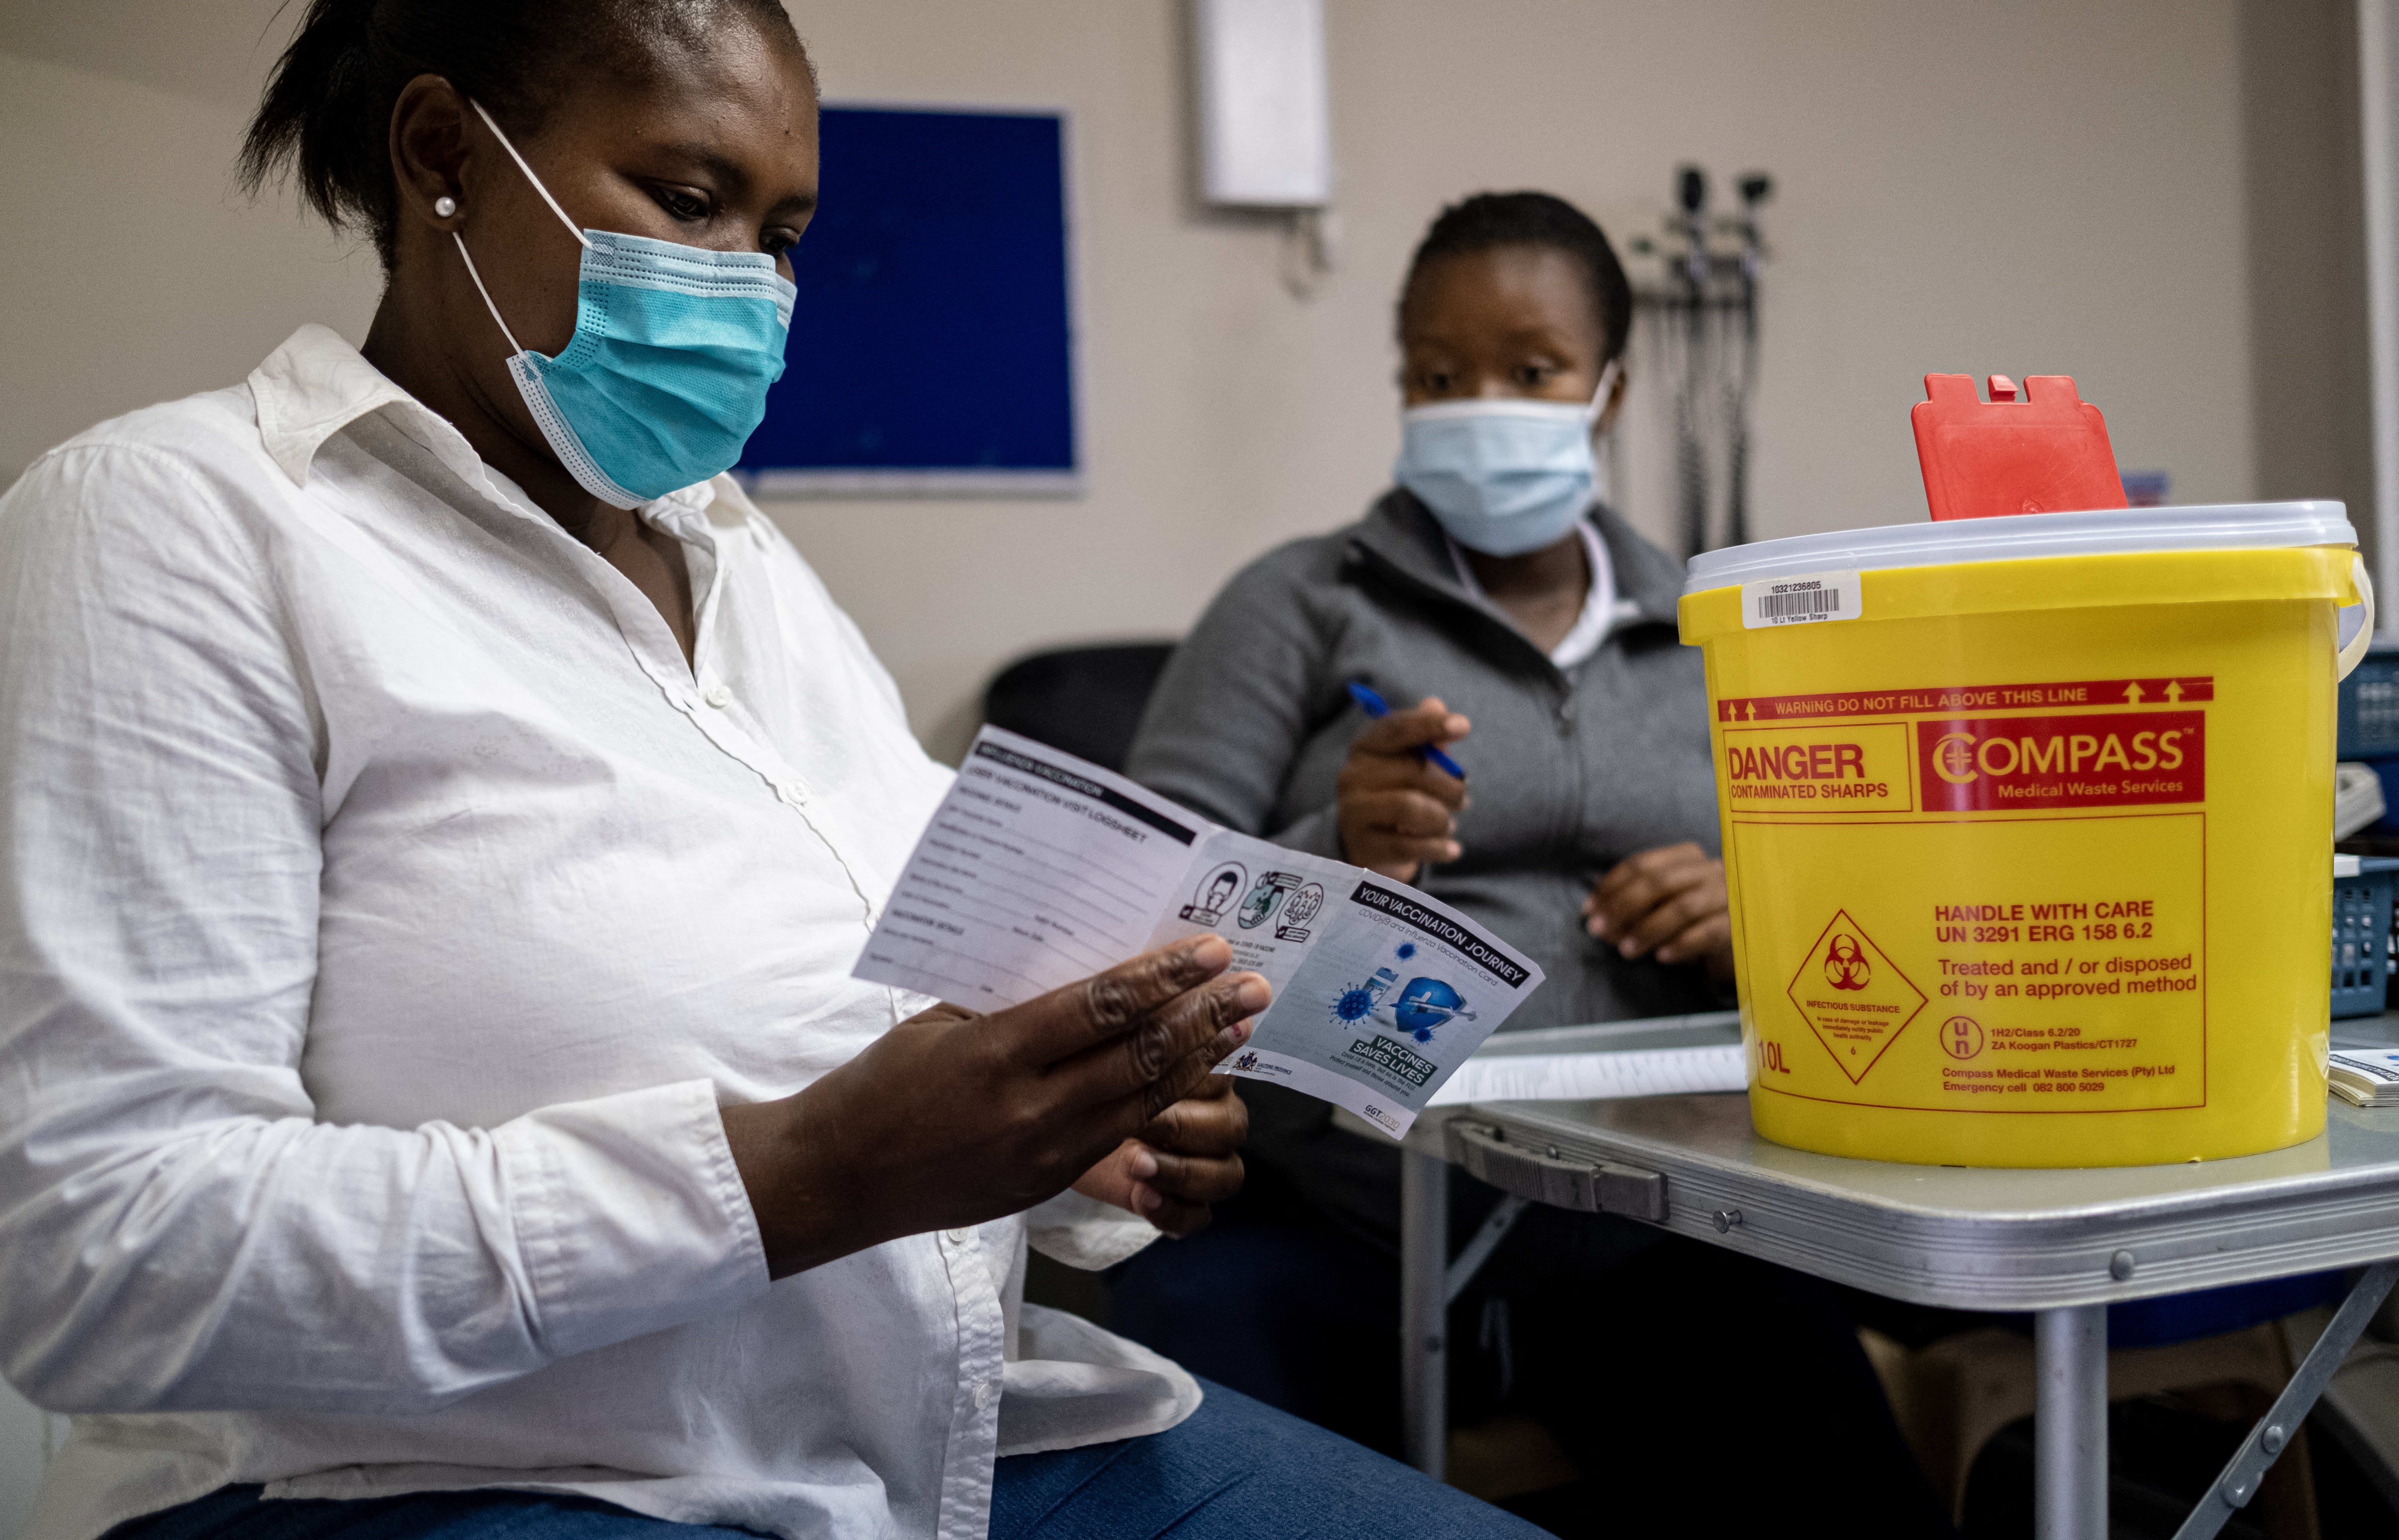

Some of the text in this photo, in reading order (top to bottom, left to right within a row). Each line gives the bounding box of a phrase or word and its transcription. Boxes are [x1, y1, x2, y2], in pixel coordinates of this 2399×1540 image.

[1771, 581, 1821, 594] 10321236805
[1775, 688, 2088, 714] WARNING DO NOT FILL ABOVE THIS LINE
[1729, 744, 1865, 780] DANGER
[1731, 783, 1888, 799] CONTAMINATED SHARPS
[1998, 780, 2183, 798] Medical Waste Services
[1935, 900, 2154, 921] HANDLE WITH CARE
[1360, 887, 1523, 982] YOUR VACCINATION JOURNEY
[1937, 922, 2153, 943] UN 3291 ERG 158 6.2
[1359, 908, 1499, 986] COVID-19 and Influenza Vaccination Card
[1938, 953, 2192, 976] Treated and / or disposed
[1940, 975, 2197, 1000] of by an approved method
[1806, 1000, 1900, 1013] INFECTIOUS SUBSTANCE
[1991, 1028, 2081, 1037] 1H2/Class 6.2/20
[1376, 1037, 1433, 1074] VACCINES
[1850, 1046, 1856, 1055] 6
[1991, 1039, 2138, 1052] ZA Koogan Plastics/CT1727
[1341, 1051, 1361, 1063] Covid-19
[1353, 1043, 1424, 1083] SAVES LIVES
[1758, 1039, 1790, 1074] 10L
[1942, 1065, 2175, 1079] Compass Medical Waste Services (Pty) Ltd
[1943, 1081, 2105, 1093] Emergency cell 082 800 5029
[1365, 1105, 1400, 1129] GGT2030
